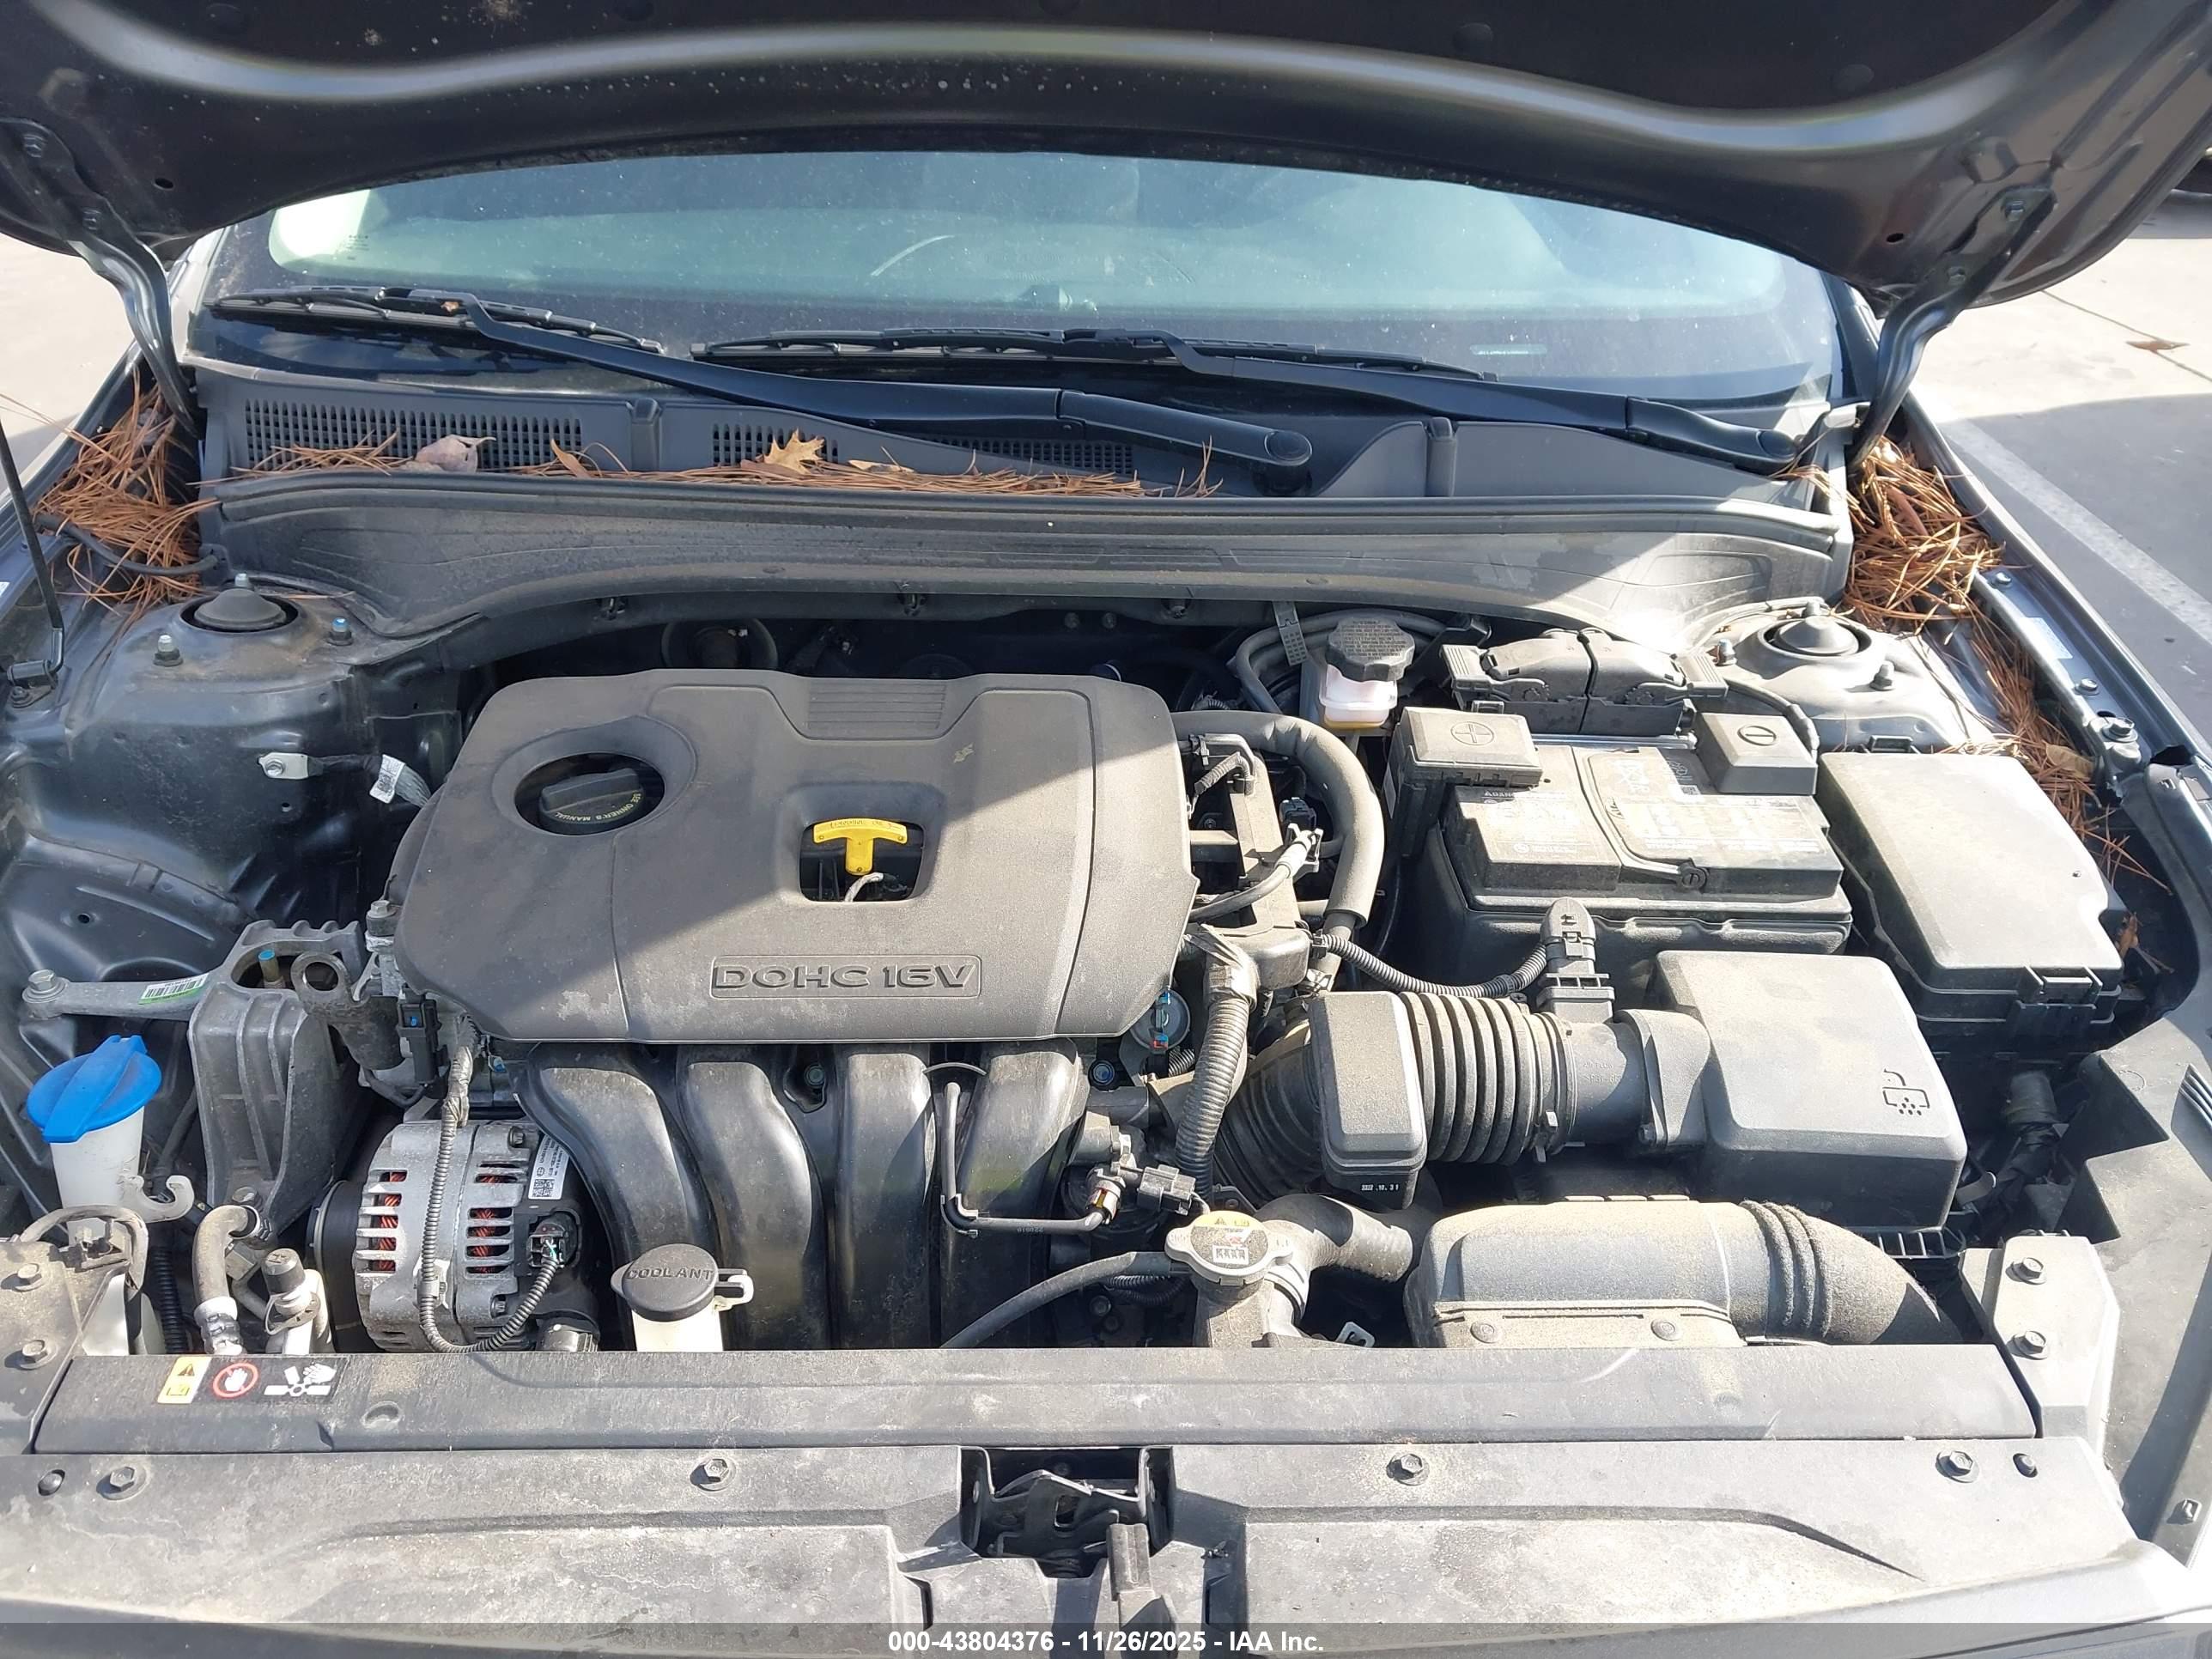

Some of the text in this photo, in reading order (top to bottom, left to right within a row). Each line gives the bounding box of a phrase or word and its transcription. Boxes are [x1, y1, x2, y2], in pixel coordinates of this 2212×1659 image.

[554, 811, 592, 821] MANUAL
[595, 803, 634, 820] OWNER'S
[713, 963, 976, 988] DOHC 16V
[627, 1267, 714, 1280] COOLANT
